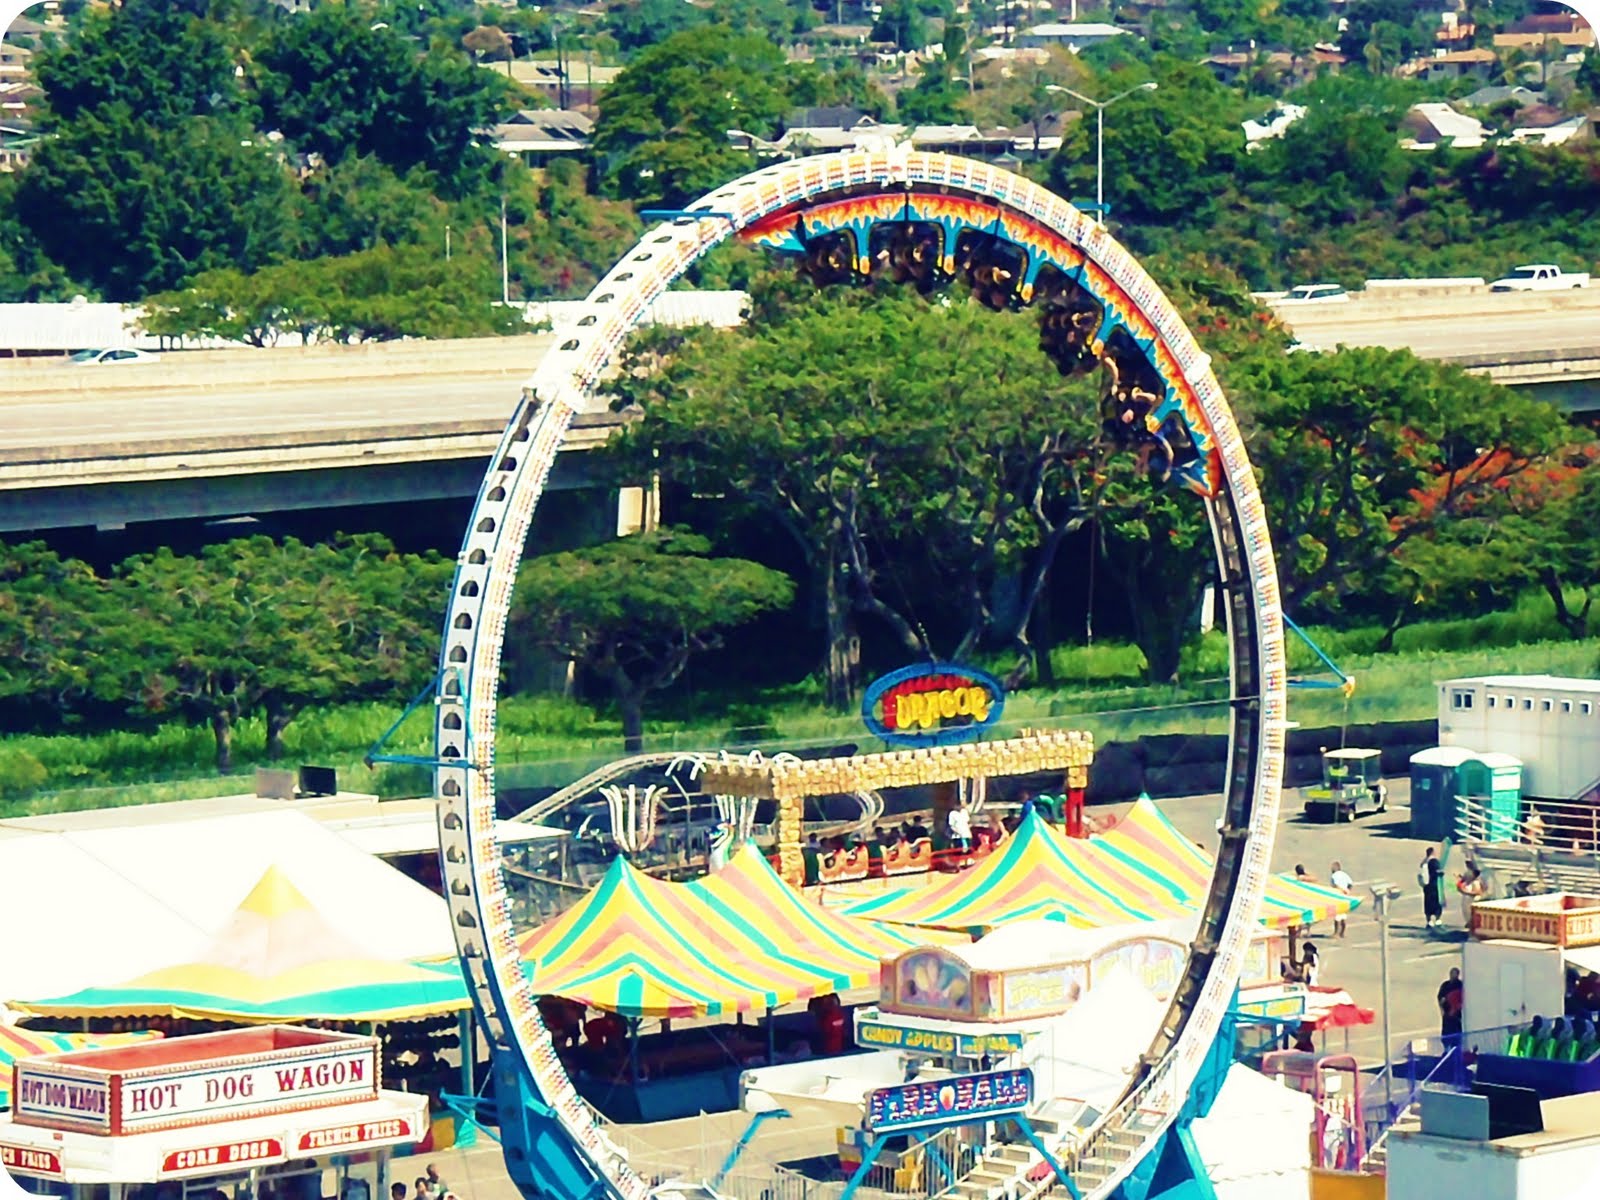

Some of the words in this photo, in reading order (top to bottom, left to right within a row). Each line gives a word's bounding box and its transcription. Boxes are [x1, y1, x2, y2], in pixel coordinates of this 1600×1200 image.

[861, 1026, 902, 1044] CANDY
[906, 1031, 954, 1051] APPLES
[21, 1079, 44, 1105] HOT
[45, 1082, 66, 1108] DOG
[68, 1086, 106, 1114] WAGON
[130, 1084, 182, 1114] HOT
[205, 1074, 254, 1103] DOG
[275, 1059, 365, 1092] WAGON
[308, 1126, 360, 1148] FRENCH
[363, 1120, 401, 1140] FRIES
[176, 1148, 219, 1168] CORN
[229, 1141, 269, 1161] DOGS
